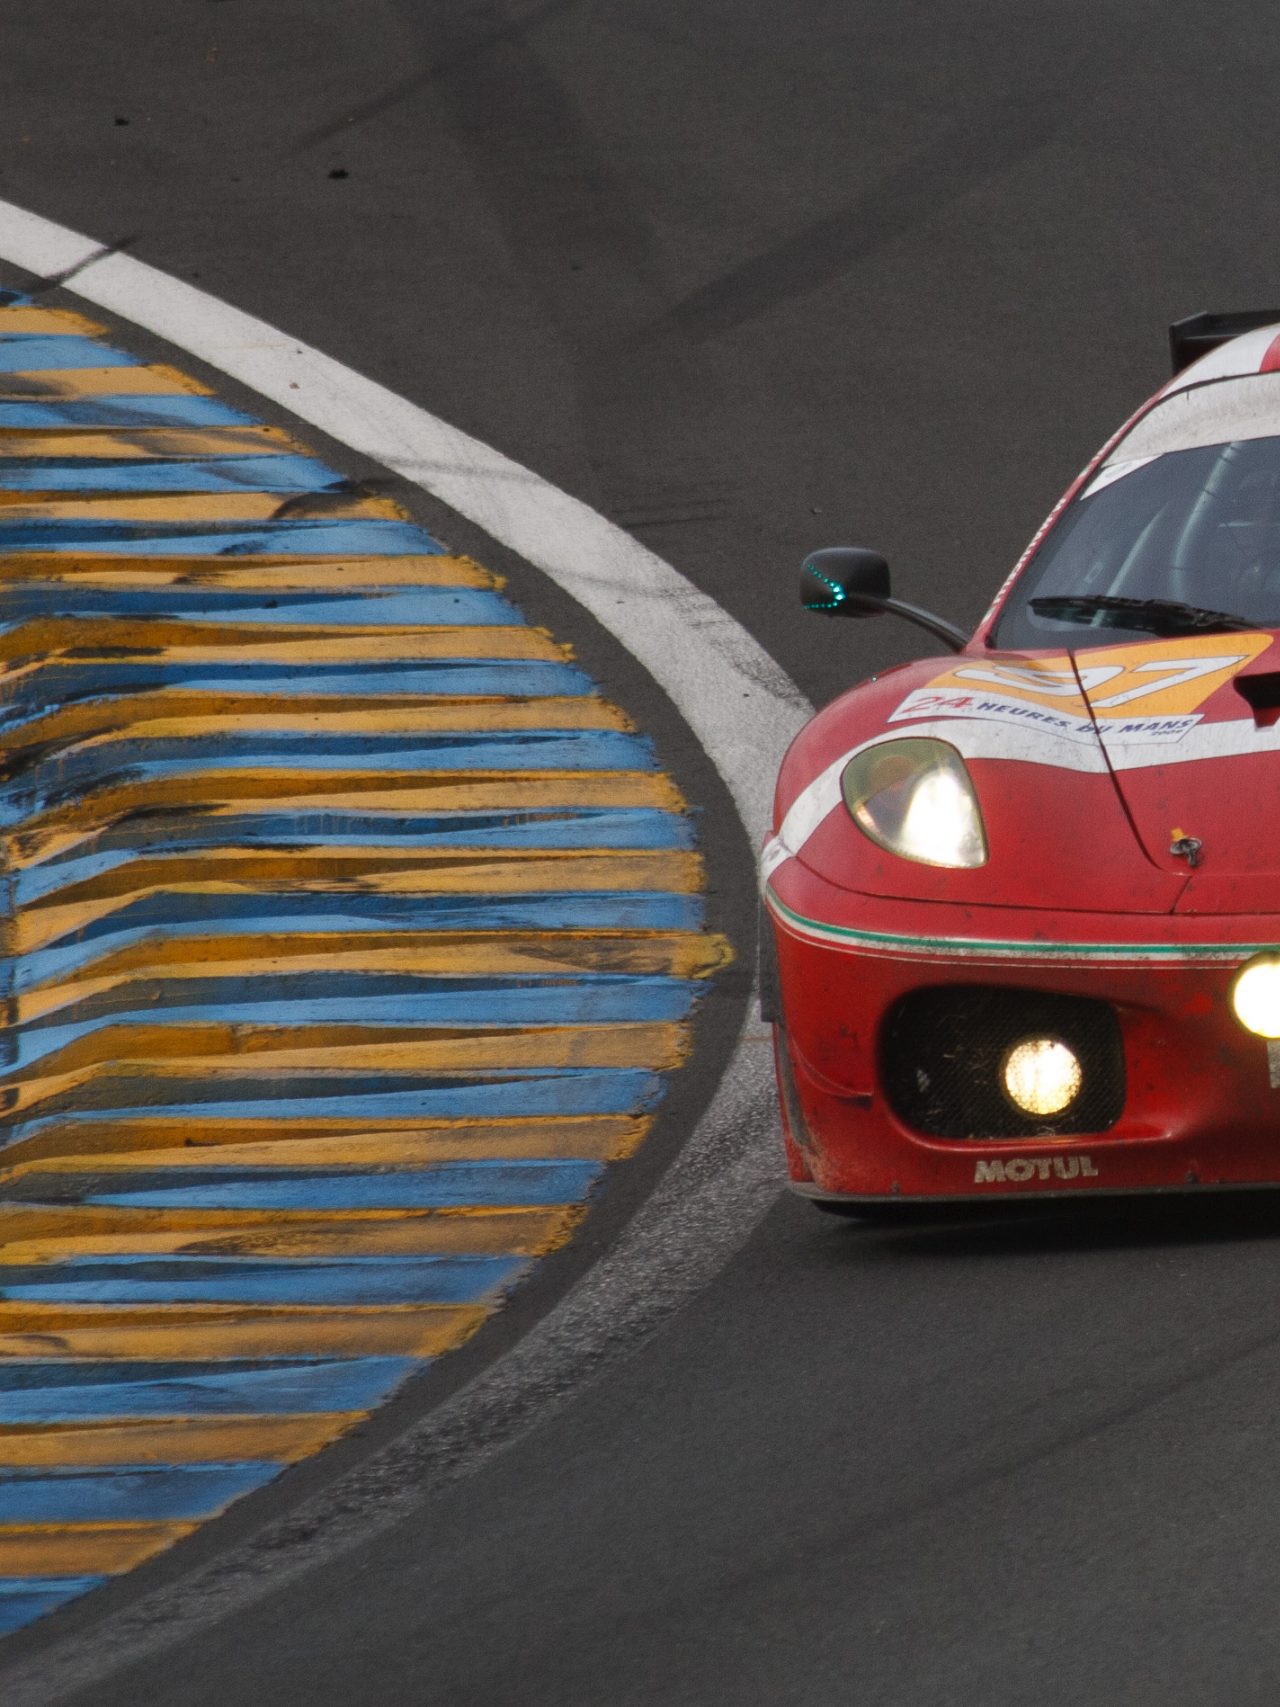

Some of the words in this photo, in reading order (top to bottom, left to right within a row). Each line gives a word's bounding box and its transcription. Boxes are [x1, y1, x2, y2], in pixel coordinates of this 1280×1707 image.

[954, 655, 1250, 708] 97
[898, 696, 974, 713] 24
[977, 702, 1072, 727] HEURES
[1118, 719, 1194, 733] MANS
[974, 1156, 1098, 1183] MOTUL
